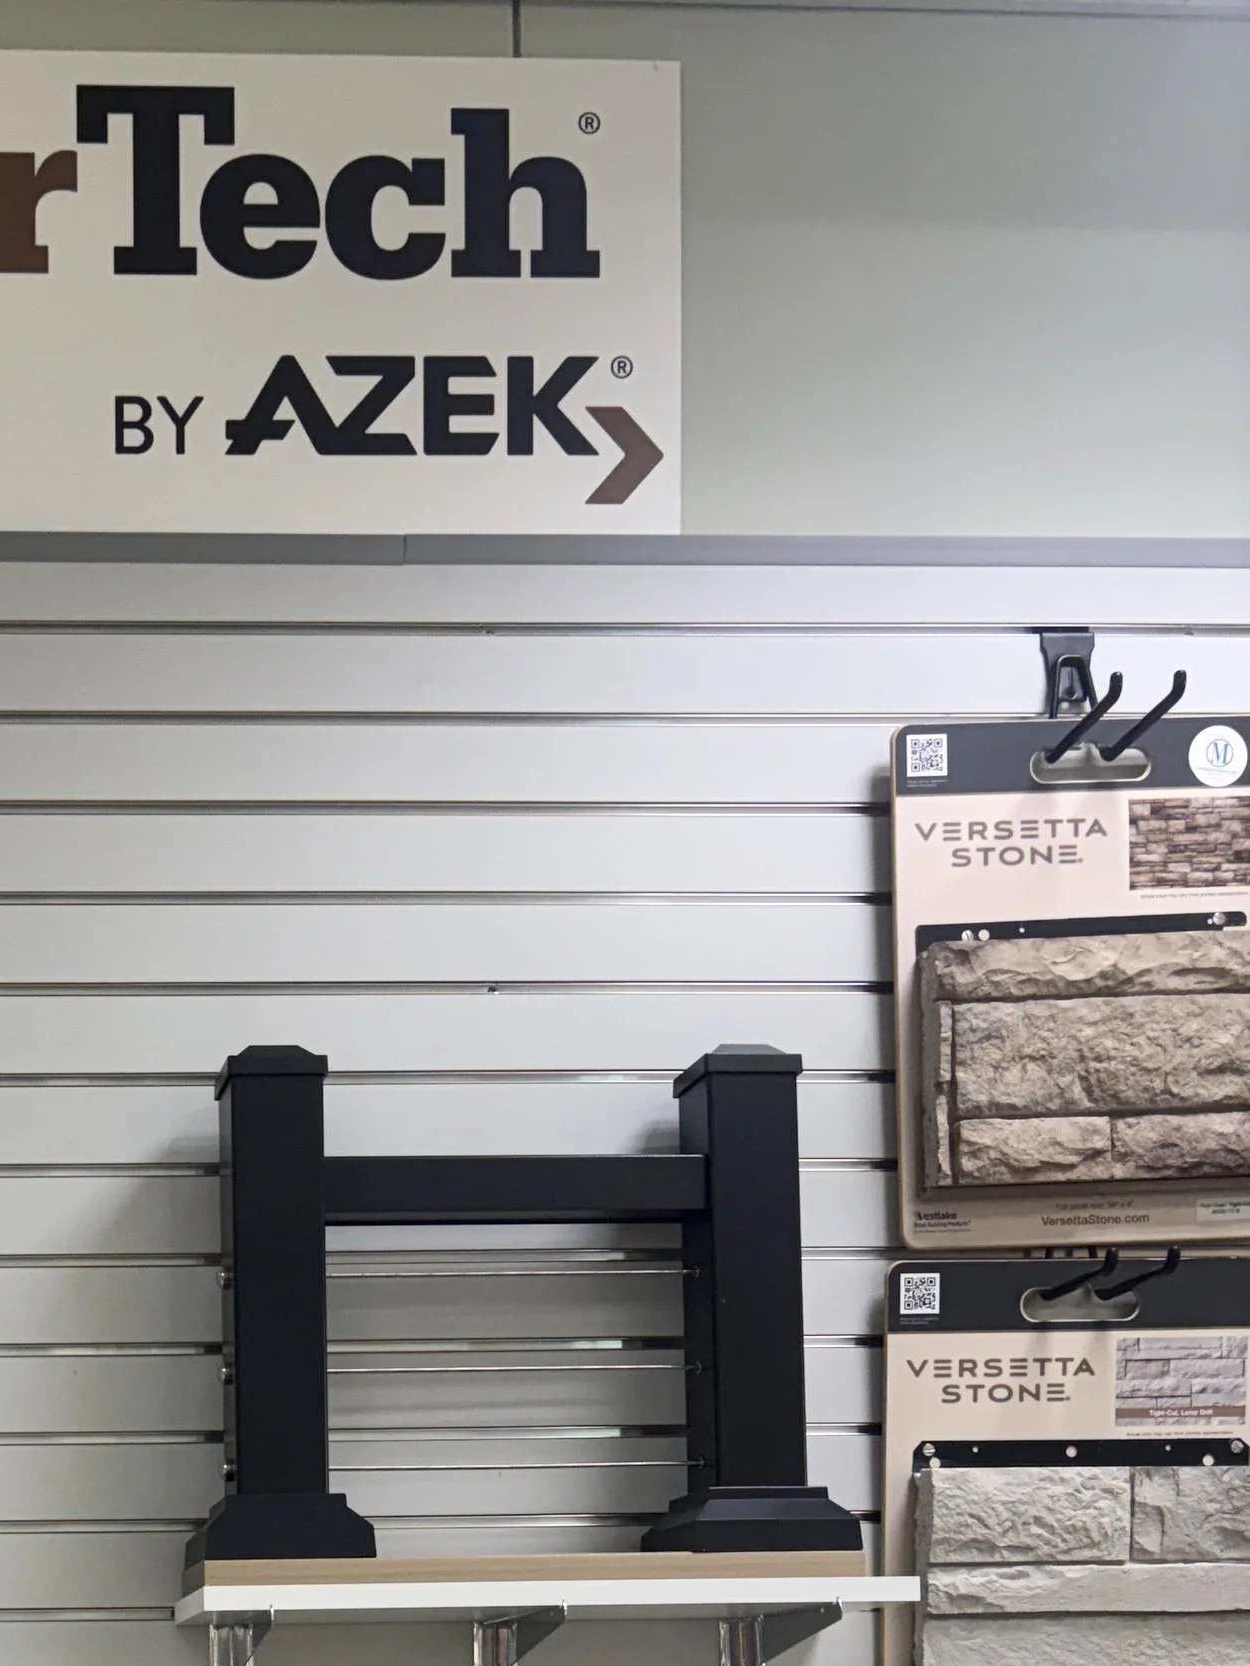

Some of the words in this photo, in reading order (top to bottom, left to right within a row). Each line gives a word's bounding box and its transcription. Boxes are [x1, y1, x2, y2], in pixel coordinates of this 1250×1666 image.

[113, 395, 204, 455] BY
[914, 817, 1108, 842] VERSETTA
[1041, 1213, 1150, 1227] VersettaStone.com
[906, 1357, 1095, 1379] VERSETTA
